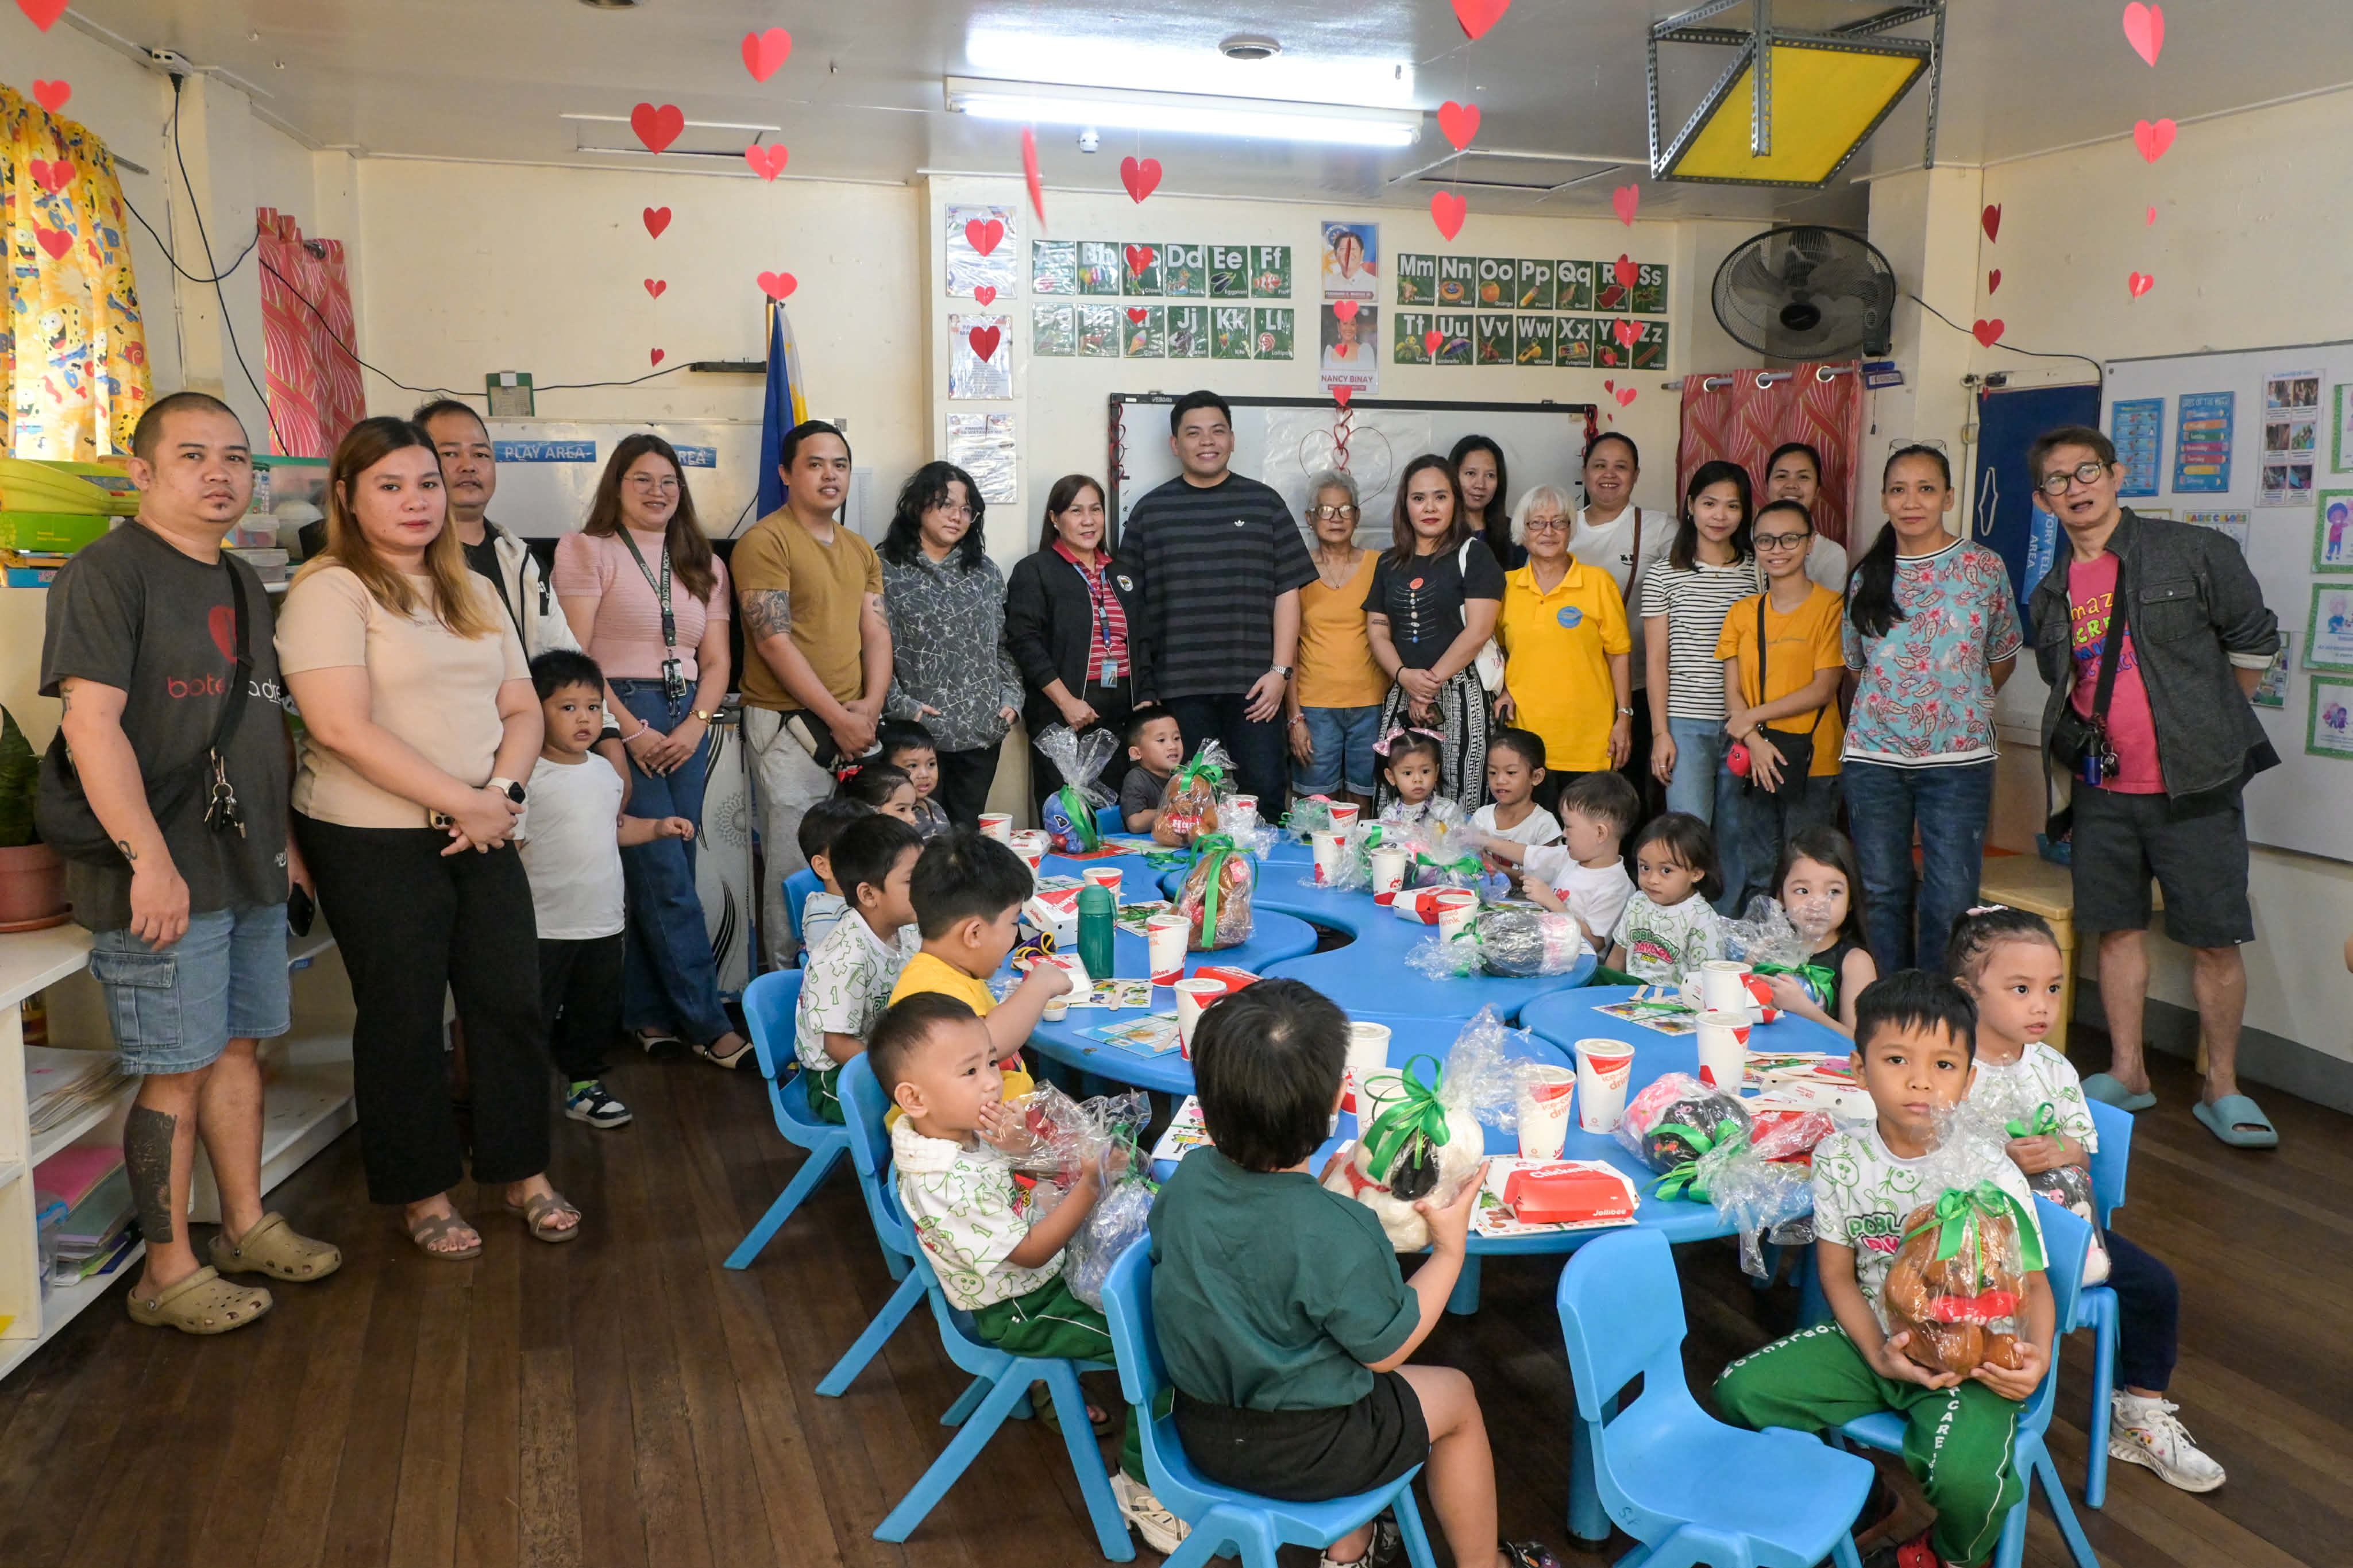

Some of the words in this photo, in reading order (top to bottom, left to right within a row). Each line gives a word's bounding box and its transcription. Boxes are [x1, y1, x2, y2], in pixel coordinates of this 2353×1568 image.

[1167, 245, 1203, 268] Dd
[1213, 247, 1243, 269] Ee
[1260, 247, 1282, 269] Ff
[1400, 255, 1433, 276] Mm
[1442, 258, 1472, 279] Nn
[1480, 260, 1513, 280] Oo
[1521, 261, 1550, 285] Pp
[1559, 262, 1591, 287] Qq
[1602, 264, 1615, 284] R
[1639, 265, 1662, 285] Ss
[1177, 307, 1197, 334] Jj
[1217, 308, 1245, 329] Kk
[1266, 310, 1282, 330] Ll
[1403, 315, 1425, 335] Tt
[1440, 317, 1468, 337] Uu
[1480, 316, 1509, 337] Vv
[1518, 318, 1551, 338] Ww
[1559, 319, 1590, 339] Xx
[1639, 323, 1662, 342] Zz
[505, 446, 540, 459] PLAY
[545, 446, 585, 459] AREA
[678, 451, 707, 465] REA
[2045, 513, 2055, 545] TORY
[2027, 534, 2039, 569] AREA
[2039, 549, 2052, 580] TELL
[2072, 592, 2113, 621] maz
[1151, 969, 1170, 978] ollibee
[1600, 1066, 1630, 1083] ice-co
[1609, 1074, 1630, 1090] drin
[1549, 1101, 1571, 1119] drin
[1592, 1208, 1627, 1216] Jollibee
[1849, 1212, 1901, 1236] POBL
[1934, 1386, 1961, 1449] YCARE
